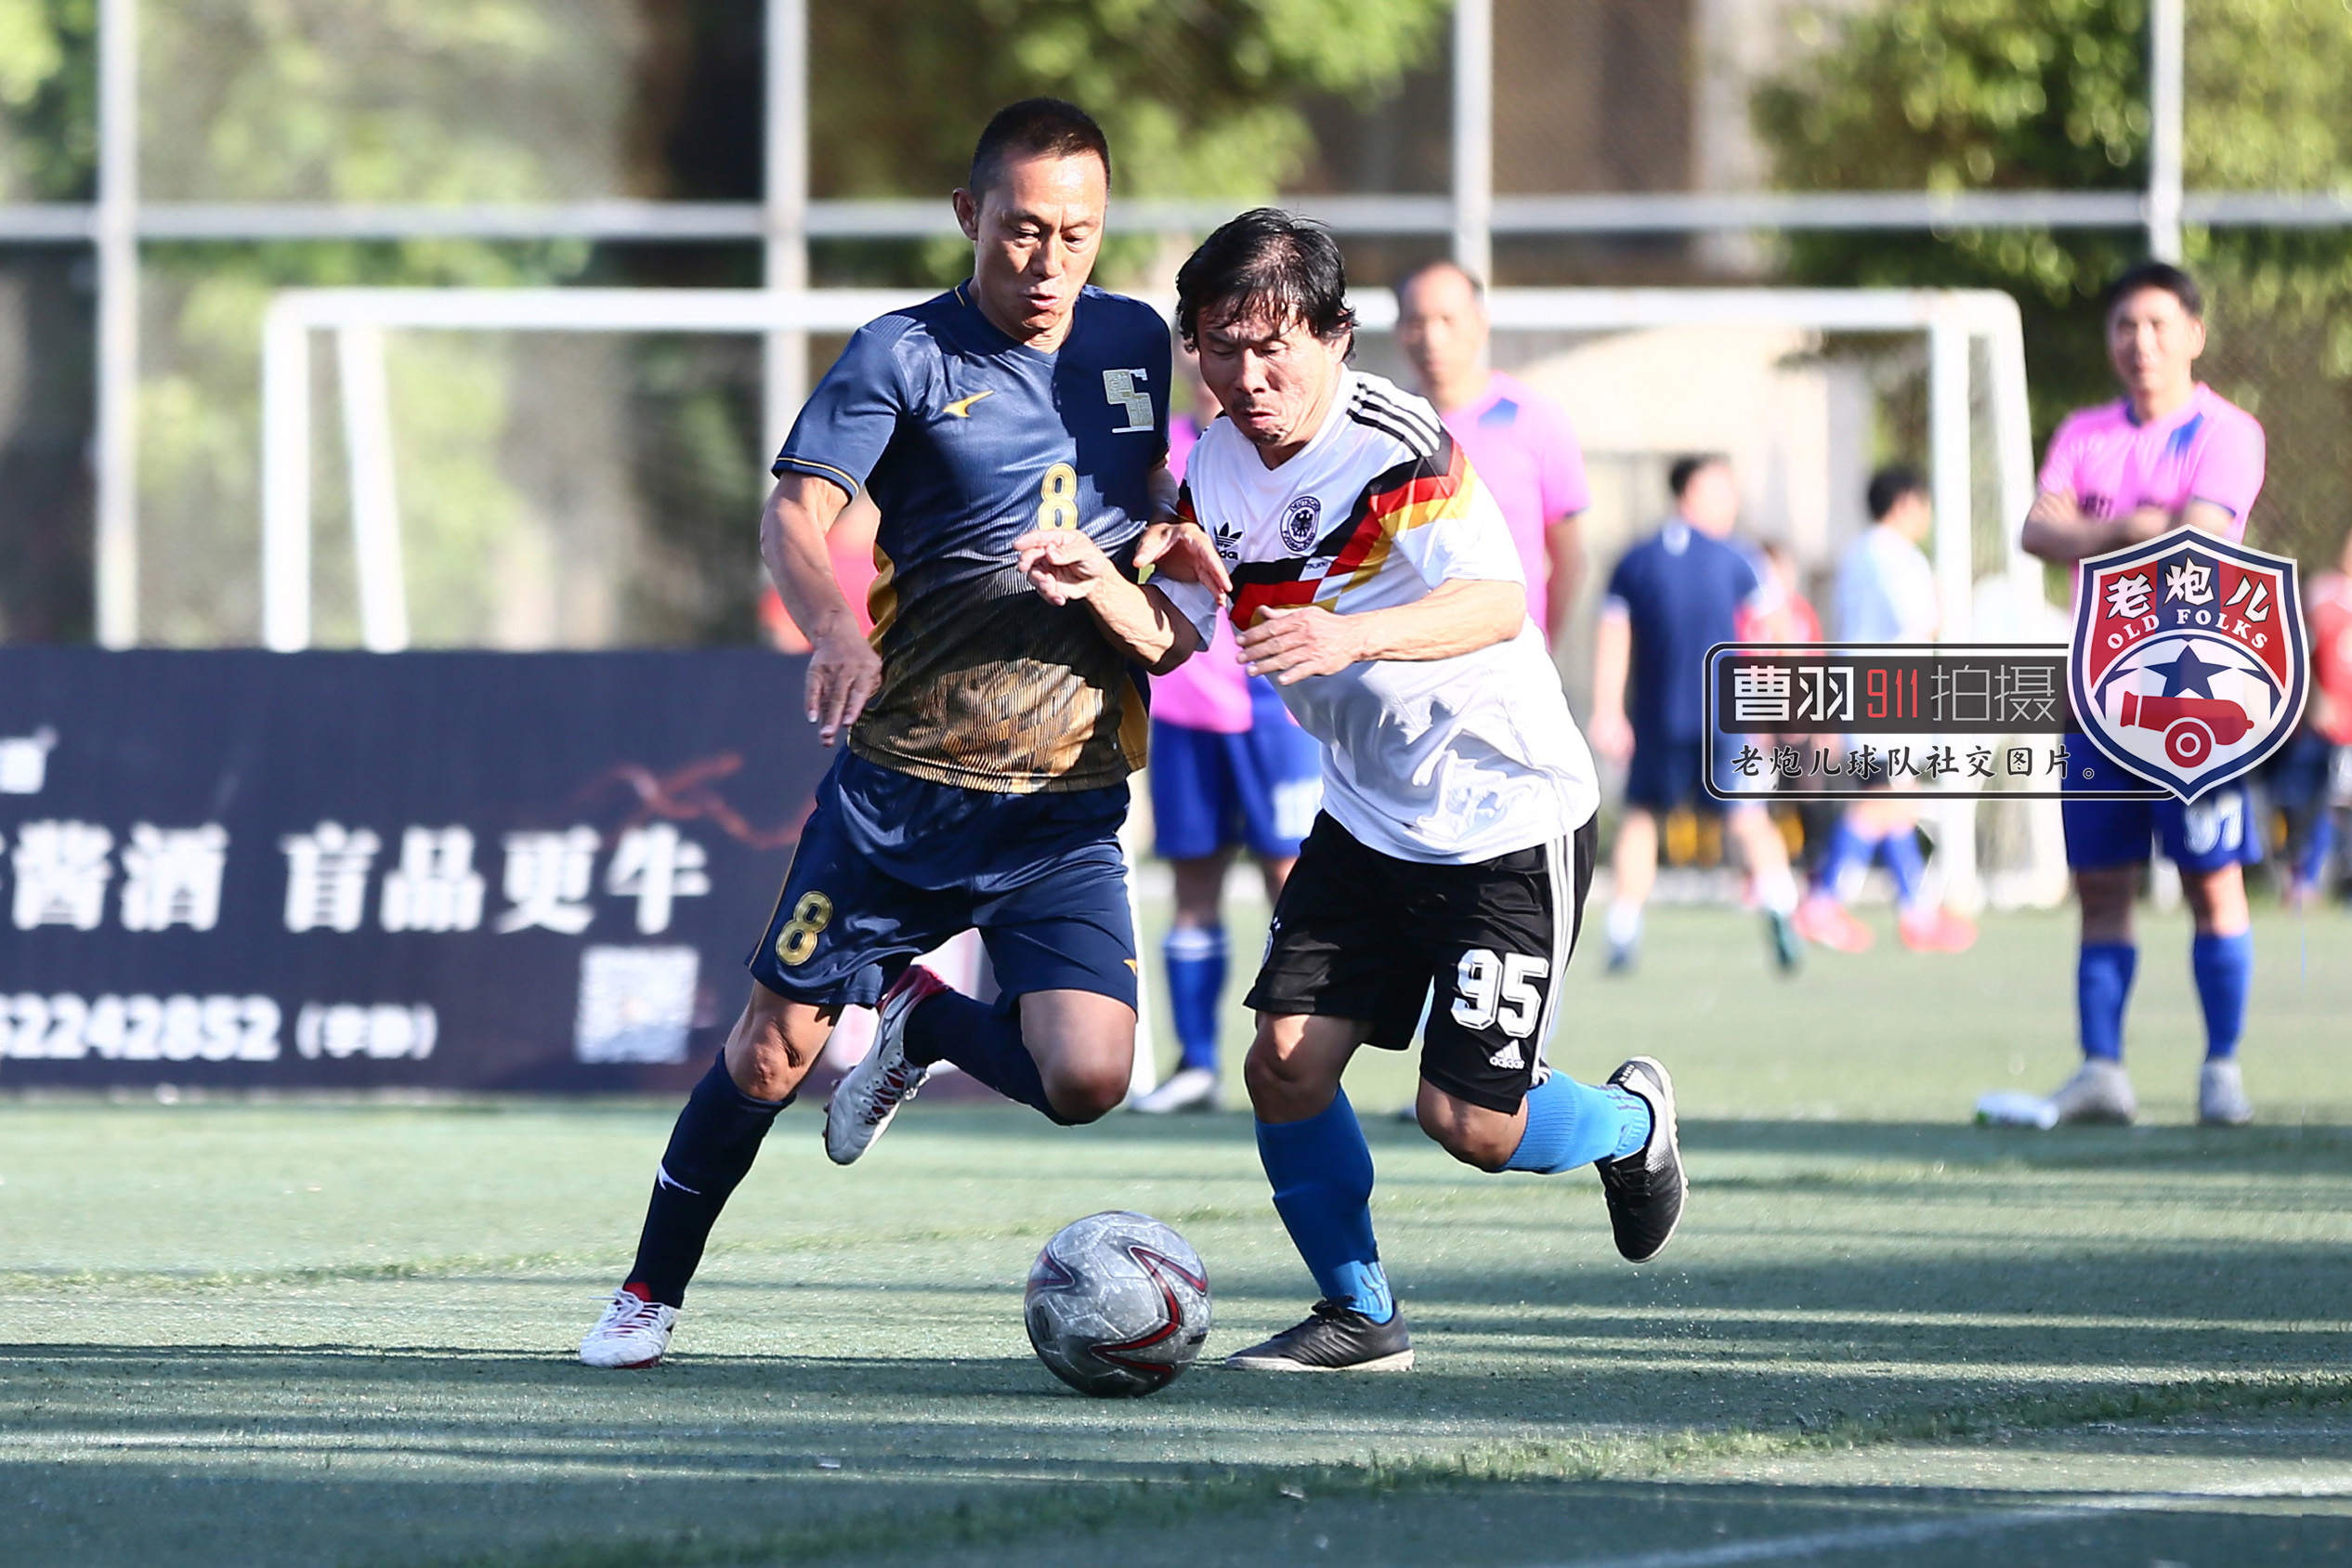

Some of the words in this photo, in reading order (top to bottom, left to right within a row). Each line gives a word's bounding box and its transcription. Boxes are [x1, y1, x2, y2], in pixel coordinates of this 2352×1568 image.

[0, 819, 229, 932] 酱酒
[279, 820, 713, 934] 盲品更牛
[776, 891, 833, 966] 8
[0, 992, 281, 1062] 2242852
[1450, 948, 1550, 1039] 95
[1489, 1055, 1525, 1070] adidas
